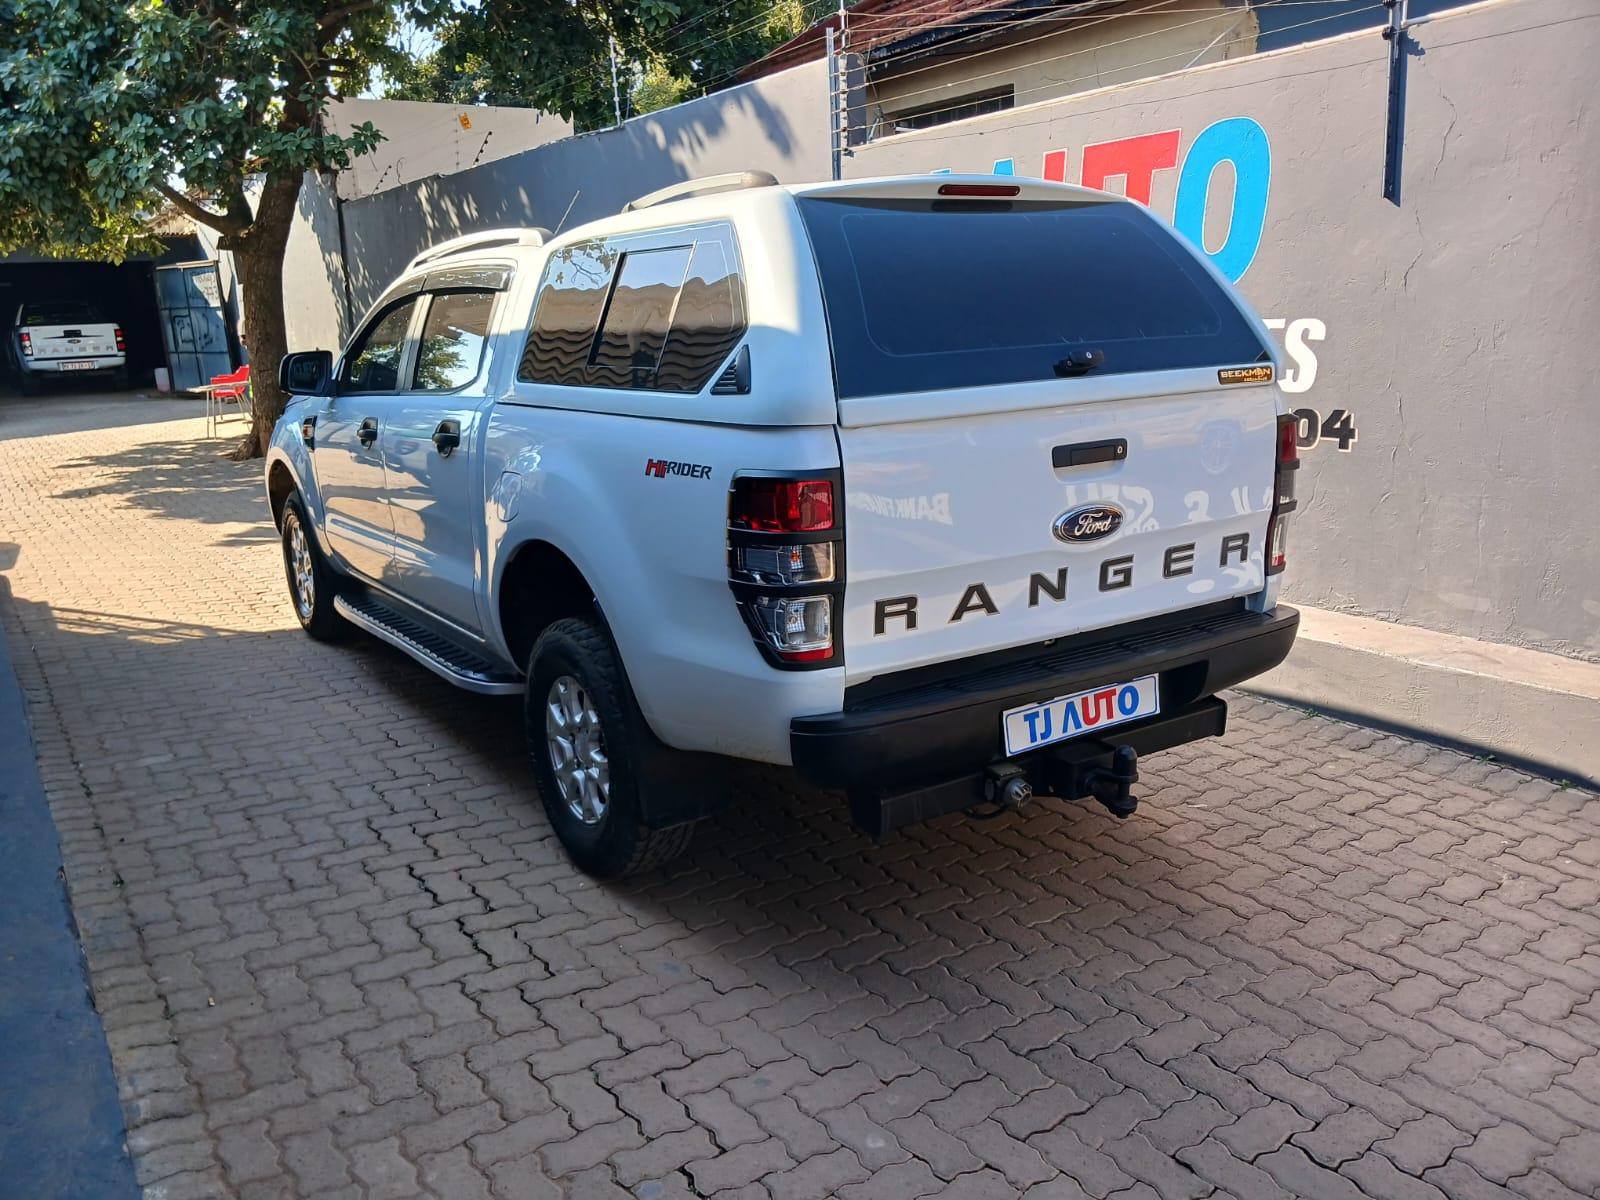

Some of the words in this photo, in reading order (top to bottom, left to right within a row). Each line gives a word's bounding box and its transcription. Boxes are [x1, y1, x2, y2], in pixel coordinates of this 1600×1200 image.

[1220, 367, 1271, 378] BEEKMAN
[1074, 511, 1113, 536] Ford
[874, 532, 1250, 636] RANGER
[1023, 707, 1053, 744] TJ
[1062, 685, 1140, 734] AUTO
